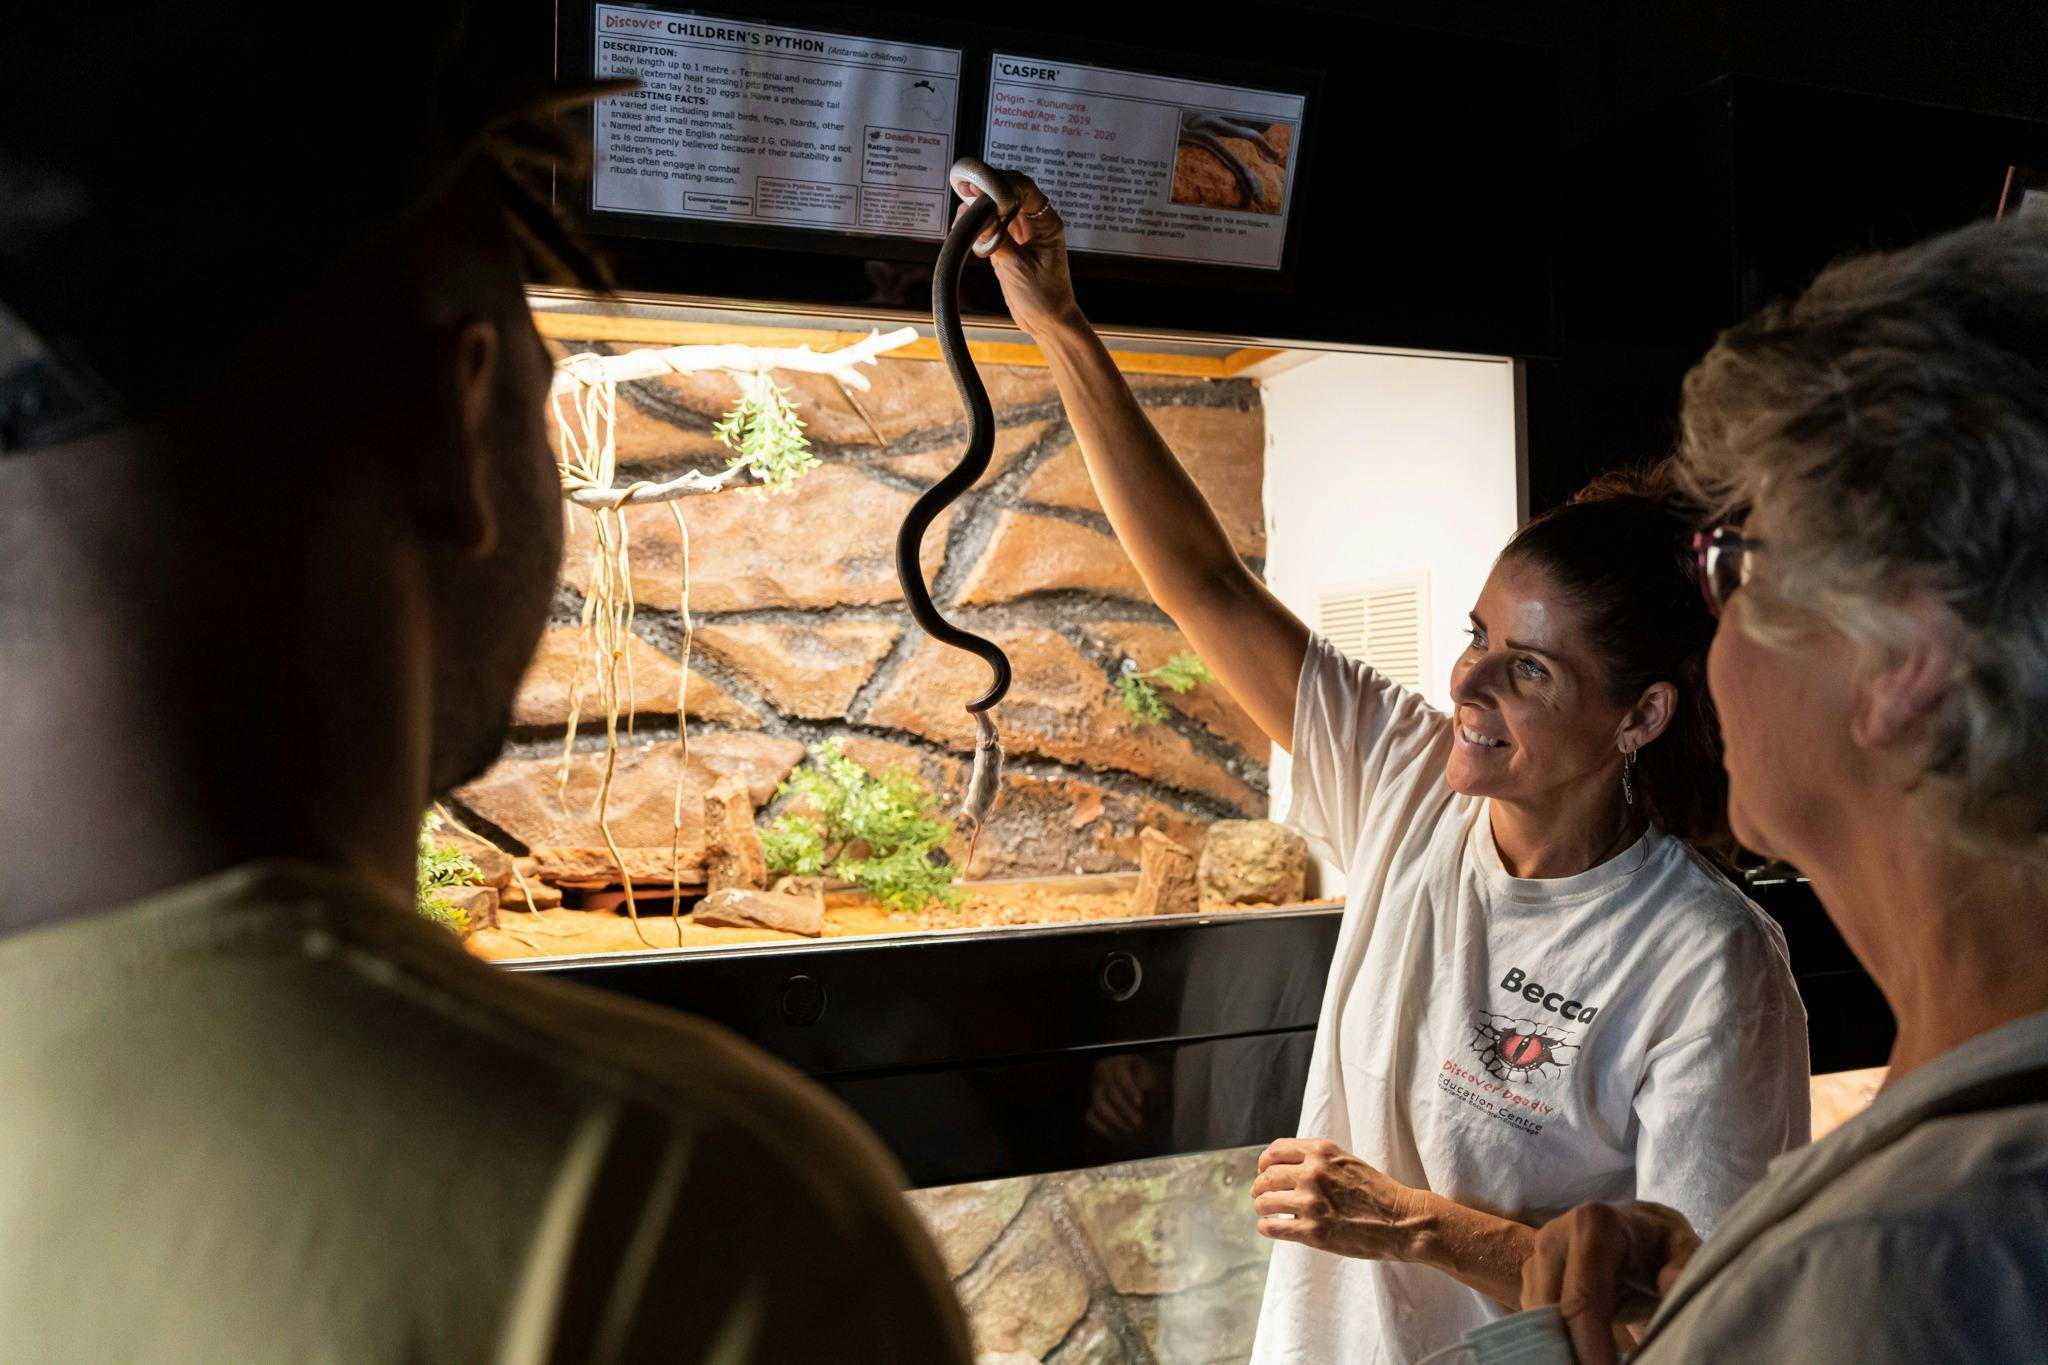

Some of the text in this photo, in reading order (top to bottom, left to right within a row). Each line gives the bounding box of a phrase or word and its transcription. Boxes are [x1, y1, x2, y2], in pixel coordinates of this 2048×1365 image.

[606, 14, 908, 64] Discover CHILDREN'S PYTHON (Antaresia childreni)
[604, 41, 678, 58] DESCRIPTION:
[612, 54, 634, 66] Body
[637, 57, 665, 69] length
[668, 62, 680, 72] up
[682, 62, 691, 71] to
[703, 66, 729, 75] metre
[612, 65, 795, 93] Labial (external heat sensing) present
[803, 78, 842, 88] nocturnal
[670, 84, 682, 94] lay
[720, 91, 741, 99] eggs
[675, 95, 710, 106] FACTS:
[782, 98, 824, 107] prehensile
[996, 93, 1087, 113] Origin Kununurra
[612, 113, 642, 121] snakes
[691, 121, 736, 130] mammals.
[620, 102, 647, 110] varied
[651, 104, 666, 112] diet
[671, 106, 709, 119] including
[738, 113, 760, 124] birds,
[764, 116, 787, 127] frogs,
[790, 118, 819, 130] lizards,
[823, 122, 845, 131] other
[995, 105, 1092, 126] Hatched/Age 2019
[610, 122, 642, 132] Named
[645, 126, 665, 134] after
[669, 128, 683, 136] the
[686, 129, 717, 140] English
[720, 134, 759, 143] naturalist
[781, 139, 817, 151] Children,
[885, 133, 941, 145] Deadly Facts
[993, 118, 1117, 142] Arrived at the Park 2020
[610, 144, 678, 157] children's pets.
[634, 137, 679, 148] commonly
[682, 141, 718, 150] believed
[722, 144, 756, 154] because
[768, 149, 788, 157] their
[790, 152, 830, 163] suitability
[868, 144, 893, 153] Rating:
[991, 141, 1018, 151] Casper
[1036, 146, 1065, 158] friendly
[1101, 155, 1119, 163] Good
[1137, 159, 1159, 169] trying
[610, 155, 635, 164] Males
[638, 158, 660, 167] often
[663, 162, 695, 171] engage
[867, 160, 892, 169] Family:
[991, 151, 1006, 160] find
[1024, 156, 1041, 164] little
[1086, 164, 1105, 173] really
[611, 166, 737, 184] rituals during mating season.
[1107, 176, 1132, 186] display
[1070, 182, 1109, 191] confidence
[1060, 202, 1090, 210] snorkels
[1118, 207, 1136, 216] tasty
[1500, 967, 1598, 1024] Becca
[1442, 1060, 1553, 1116] Discover Deadly
[1438, 1073, 1542, 1131] Education Centre
